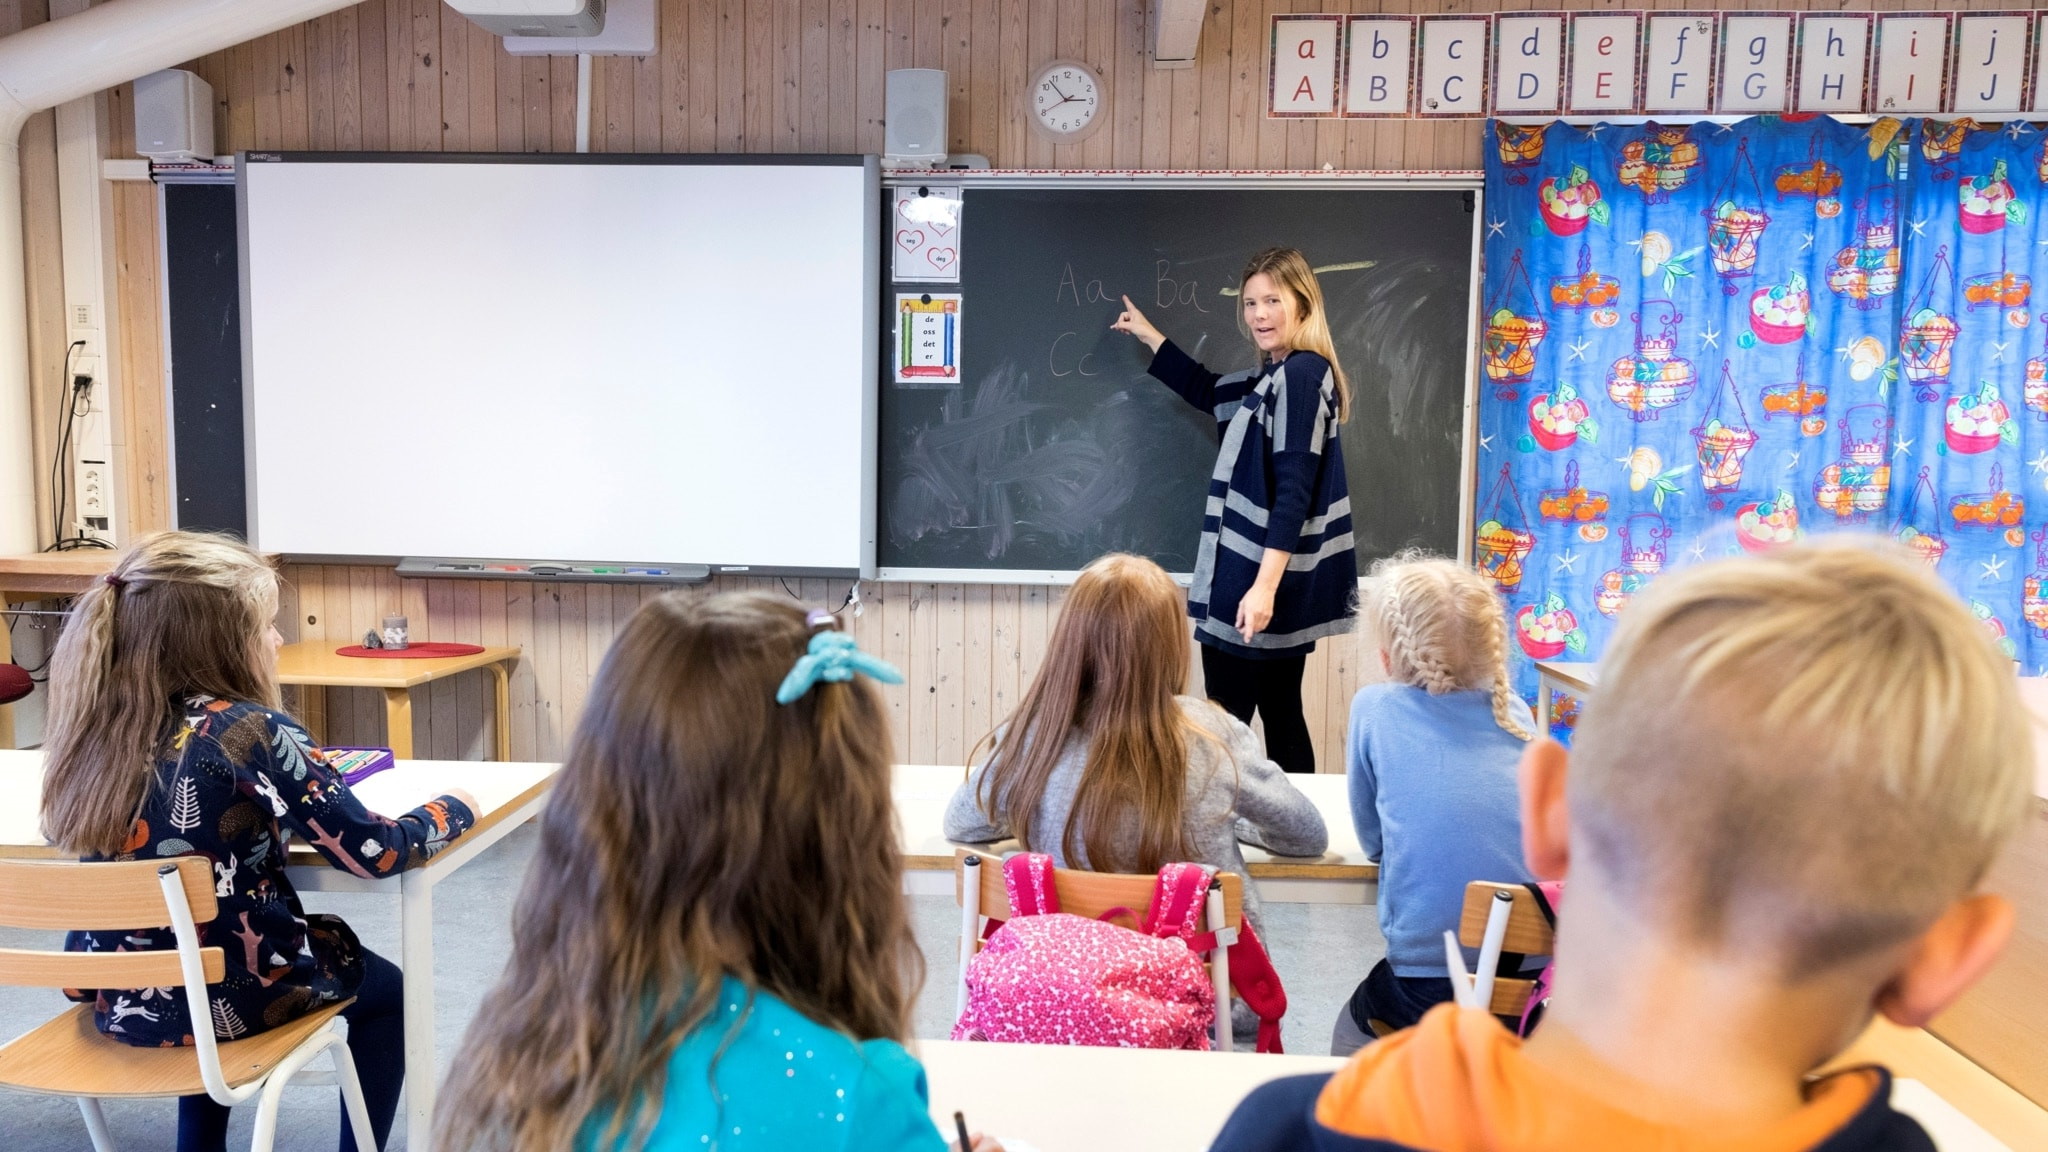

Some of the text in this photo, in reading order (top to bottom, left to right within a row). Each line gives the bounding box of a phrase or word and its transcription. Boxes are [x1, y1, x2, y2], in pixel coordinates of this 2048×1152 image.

[1298, 39, 1316, 59] a
[1372, 30, 1389, 59] b
[1447, 39, 1463, 60] c
[1521, 27, 1540, 56] d
[1598, 36, 1614, 56] e
[1671, 27, 1690, 65] f
[1749, 36, 1766, 65] g
[1826, 28, 1845, 57] h
[1910, 31, 1918, 57] i
[1982, 30, 1998, 66] j
[1042, 83, 1050, 91] 10
[1063, 71, 1072, 79] 12
[1086, 84, 1092, 92] 2
[1517, 73, 1539, 99] D
[1595, 72, 1613, 99] E
[1670, 73, 1688, 99] F
[1743, 73, 1767, 99] G
[1821, 74, 1844, 100] H
[1980, 74, 1997, 101] J
[1038, 96, 1044, 104] 9
[1088, 97, 1094, 105] 3
[1293, 76, 1315, 102] A
[1369, 76, 1388, 102] B
[1443, 76, 1464, 103] C
[1041, 109, 1047, 117] 8
[1050, 118, 1056, 126] 7
[1062, 122, 1068, 130] 6
[1075, 119, 1081, 127] 5
[1084, 110, 1090, 118] 4
[1057, 262, 1116, 306] Aa
[1050, 332, 1098, 377] Cc
